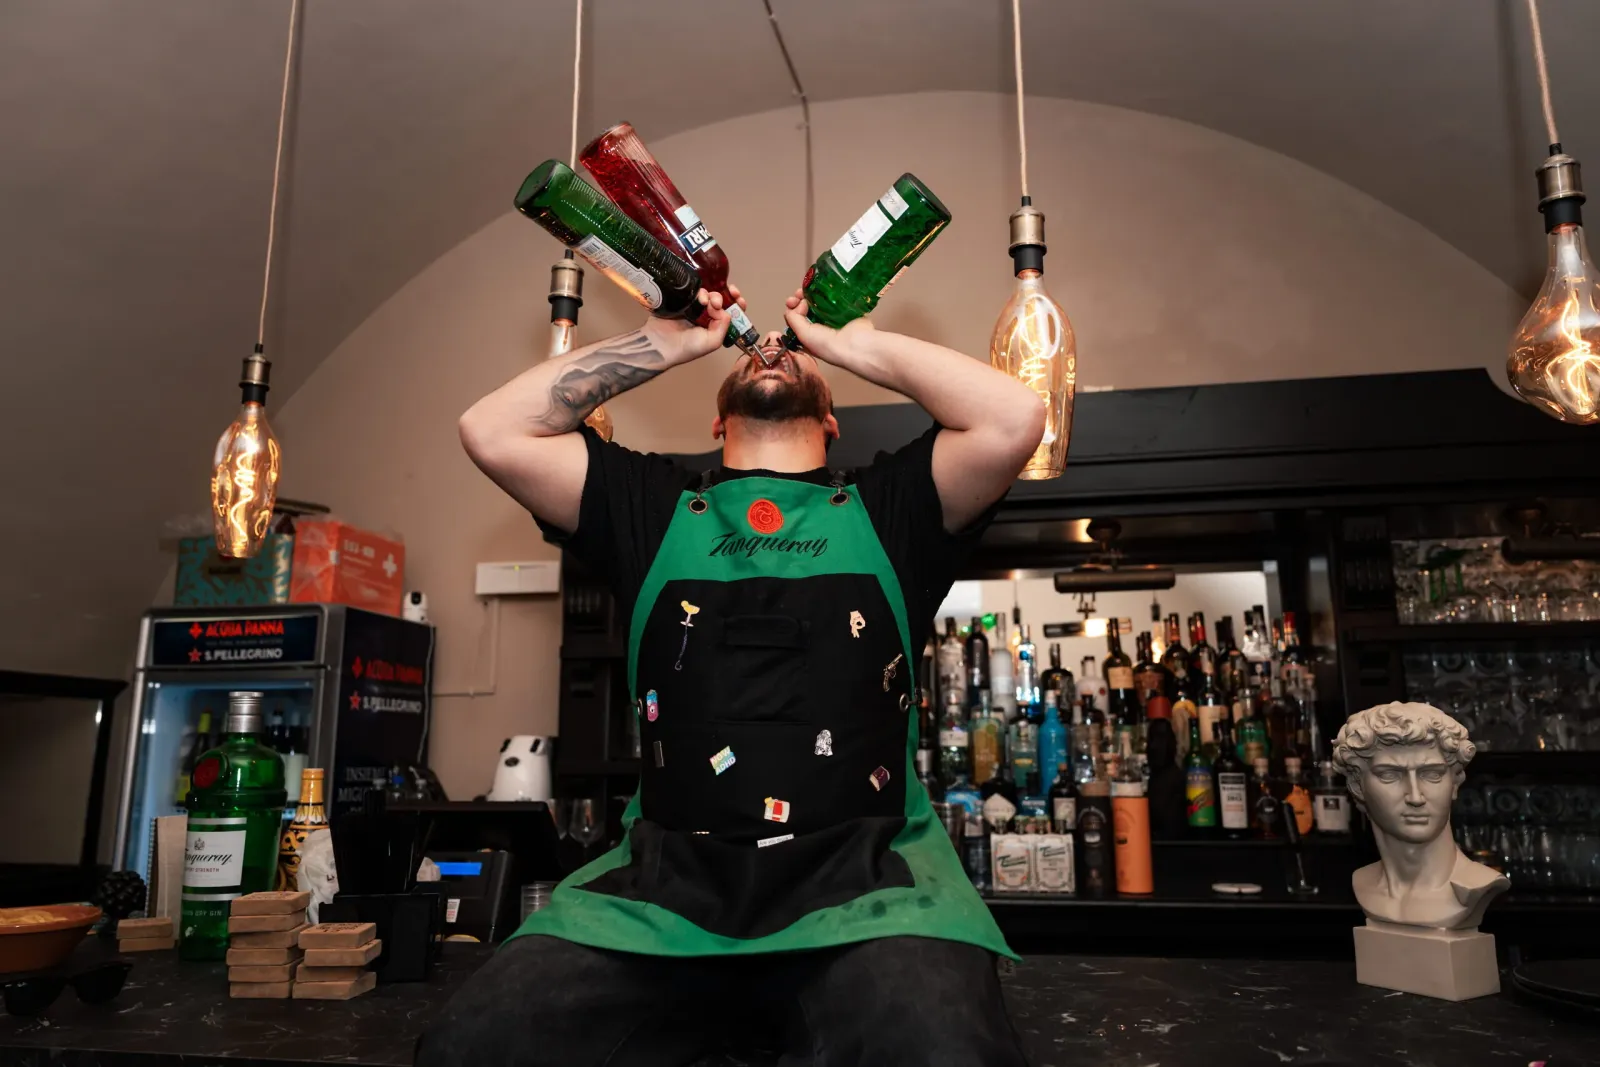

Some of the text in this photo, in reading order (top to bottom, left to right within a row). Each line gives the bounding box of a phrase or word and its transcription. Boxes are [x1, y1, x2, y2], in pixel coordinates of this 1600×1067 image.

[708, 531, 828, 558] Tanqueray
[205, 620, 284, 637] ACQUA PANNA
[204, 648, 283, 661] S.PELLEGRINO
[716, 756, 736, 775] ADHD
[185, 848, 232, 866] nqueray
